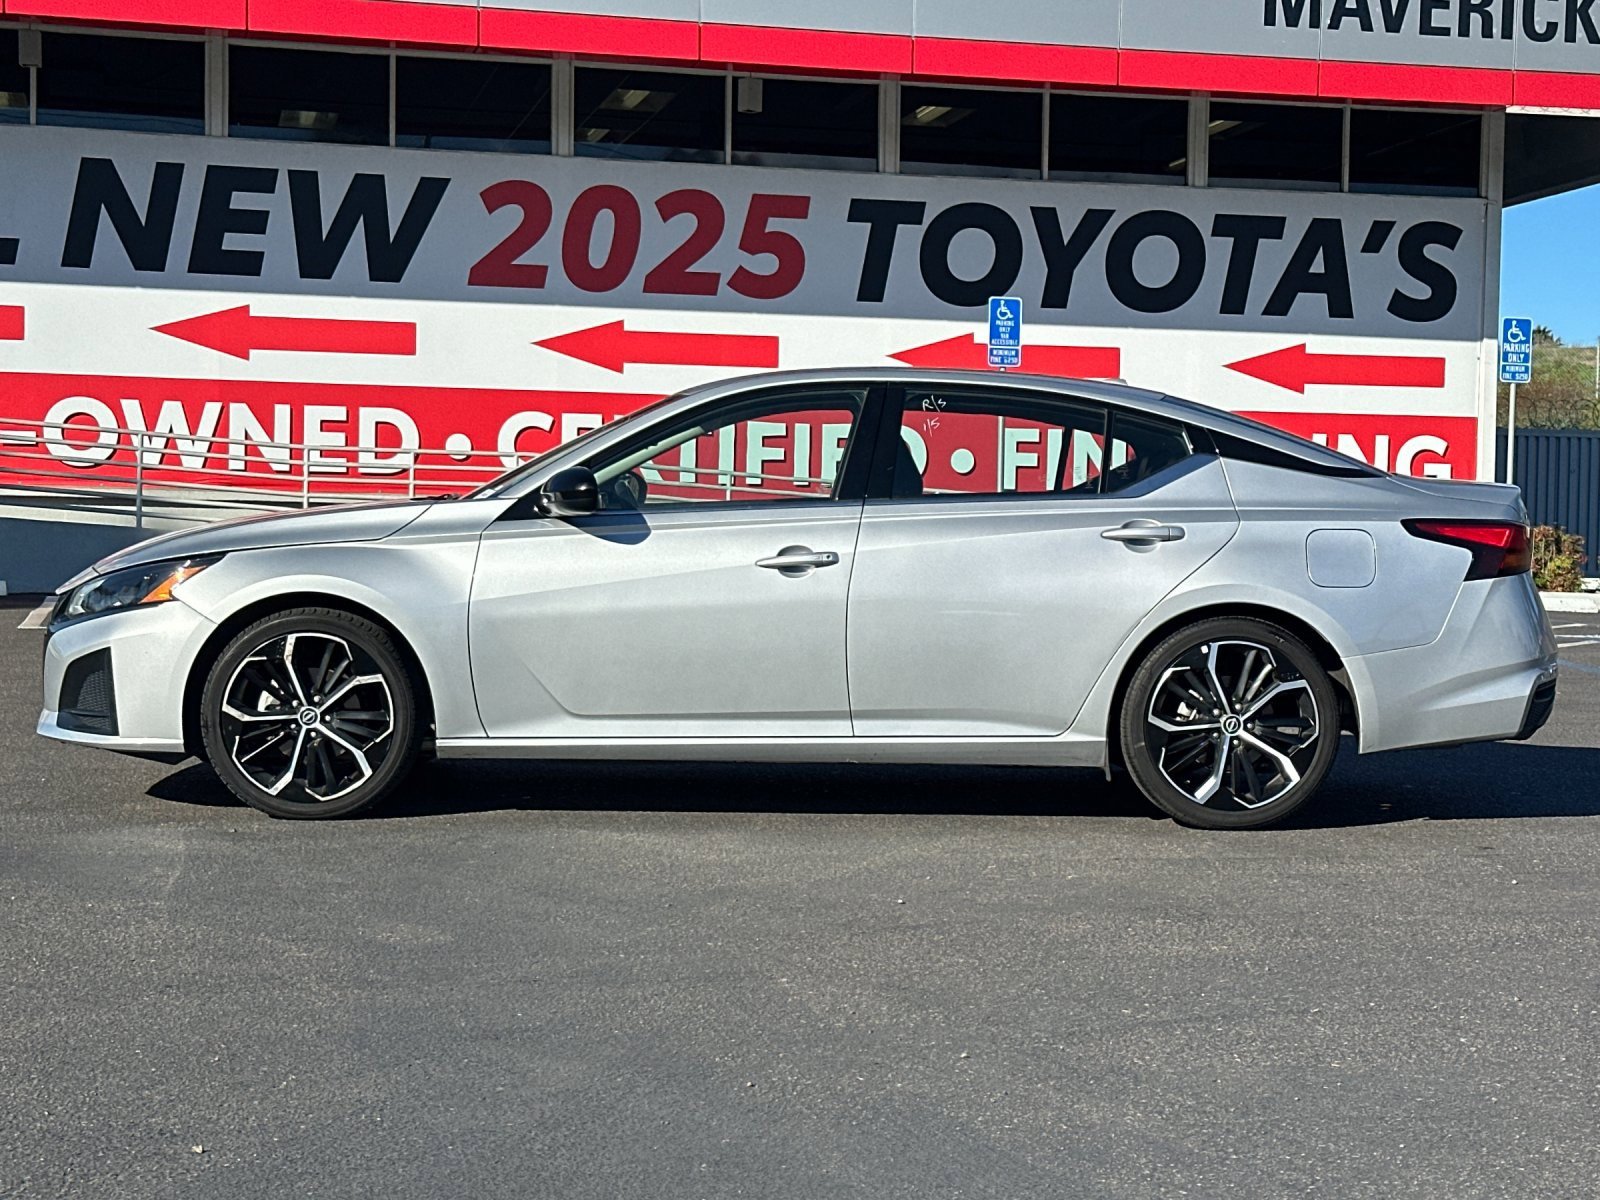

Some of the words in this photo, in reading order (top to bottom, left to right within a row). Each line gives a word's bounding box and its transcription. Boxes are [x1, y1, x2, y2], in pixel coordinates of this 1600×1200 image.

[61, 157, 451, 283] NEW
[467, 180, 811, 299] 2025
[847, 198, 1463, 323] TOYOTA'S
[1503, 342, 1530, 354] PARKING
[1508, 353, 1525, 363] ONLY
